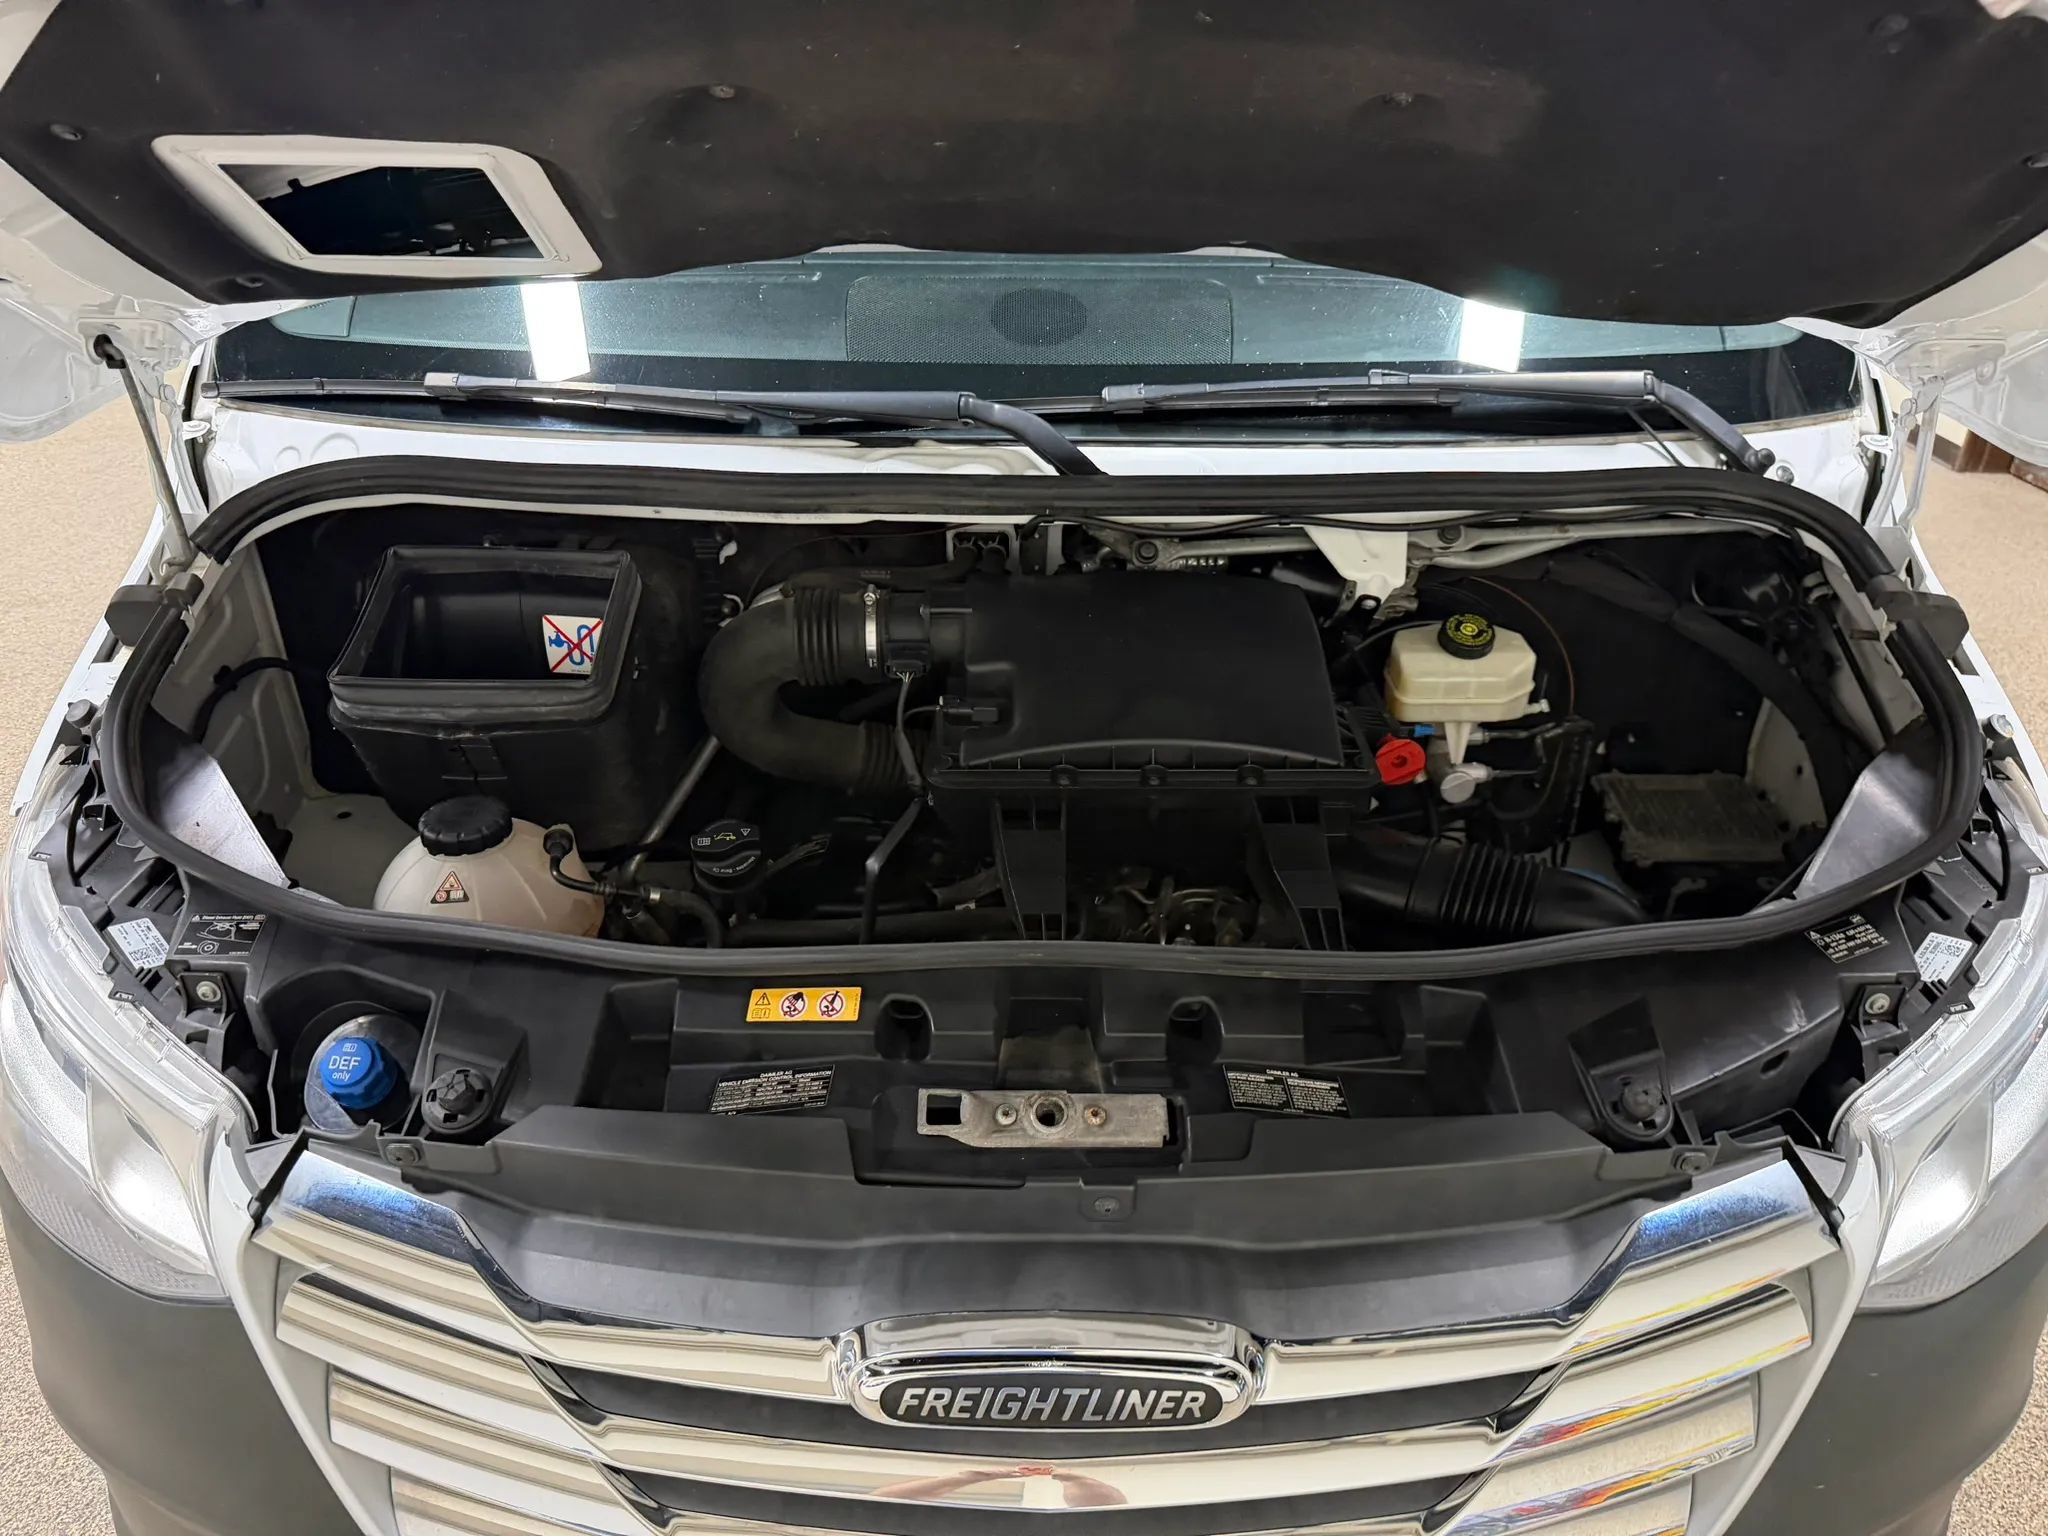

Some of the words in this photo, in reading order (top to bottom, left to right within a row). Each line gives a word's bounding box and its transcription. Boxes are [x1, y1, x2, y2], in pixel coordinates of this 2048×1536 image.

[328, 1055, 361, 1070] DEF
[332, 1071, 351, 1081] only
[742, 1077, 768, 1085] EMISSION
[794, 1070, 832, 1079] INFORMATION
[1266, 1069, 1291, 1077] DAIMLER
[896, 1386, 1208, 1422] FREIGHTLINER
